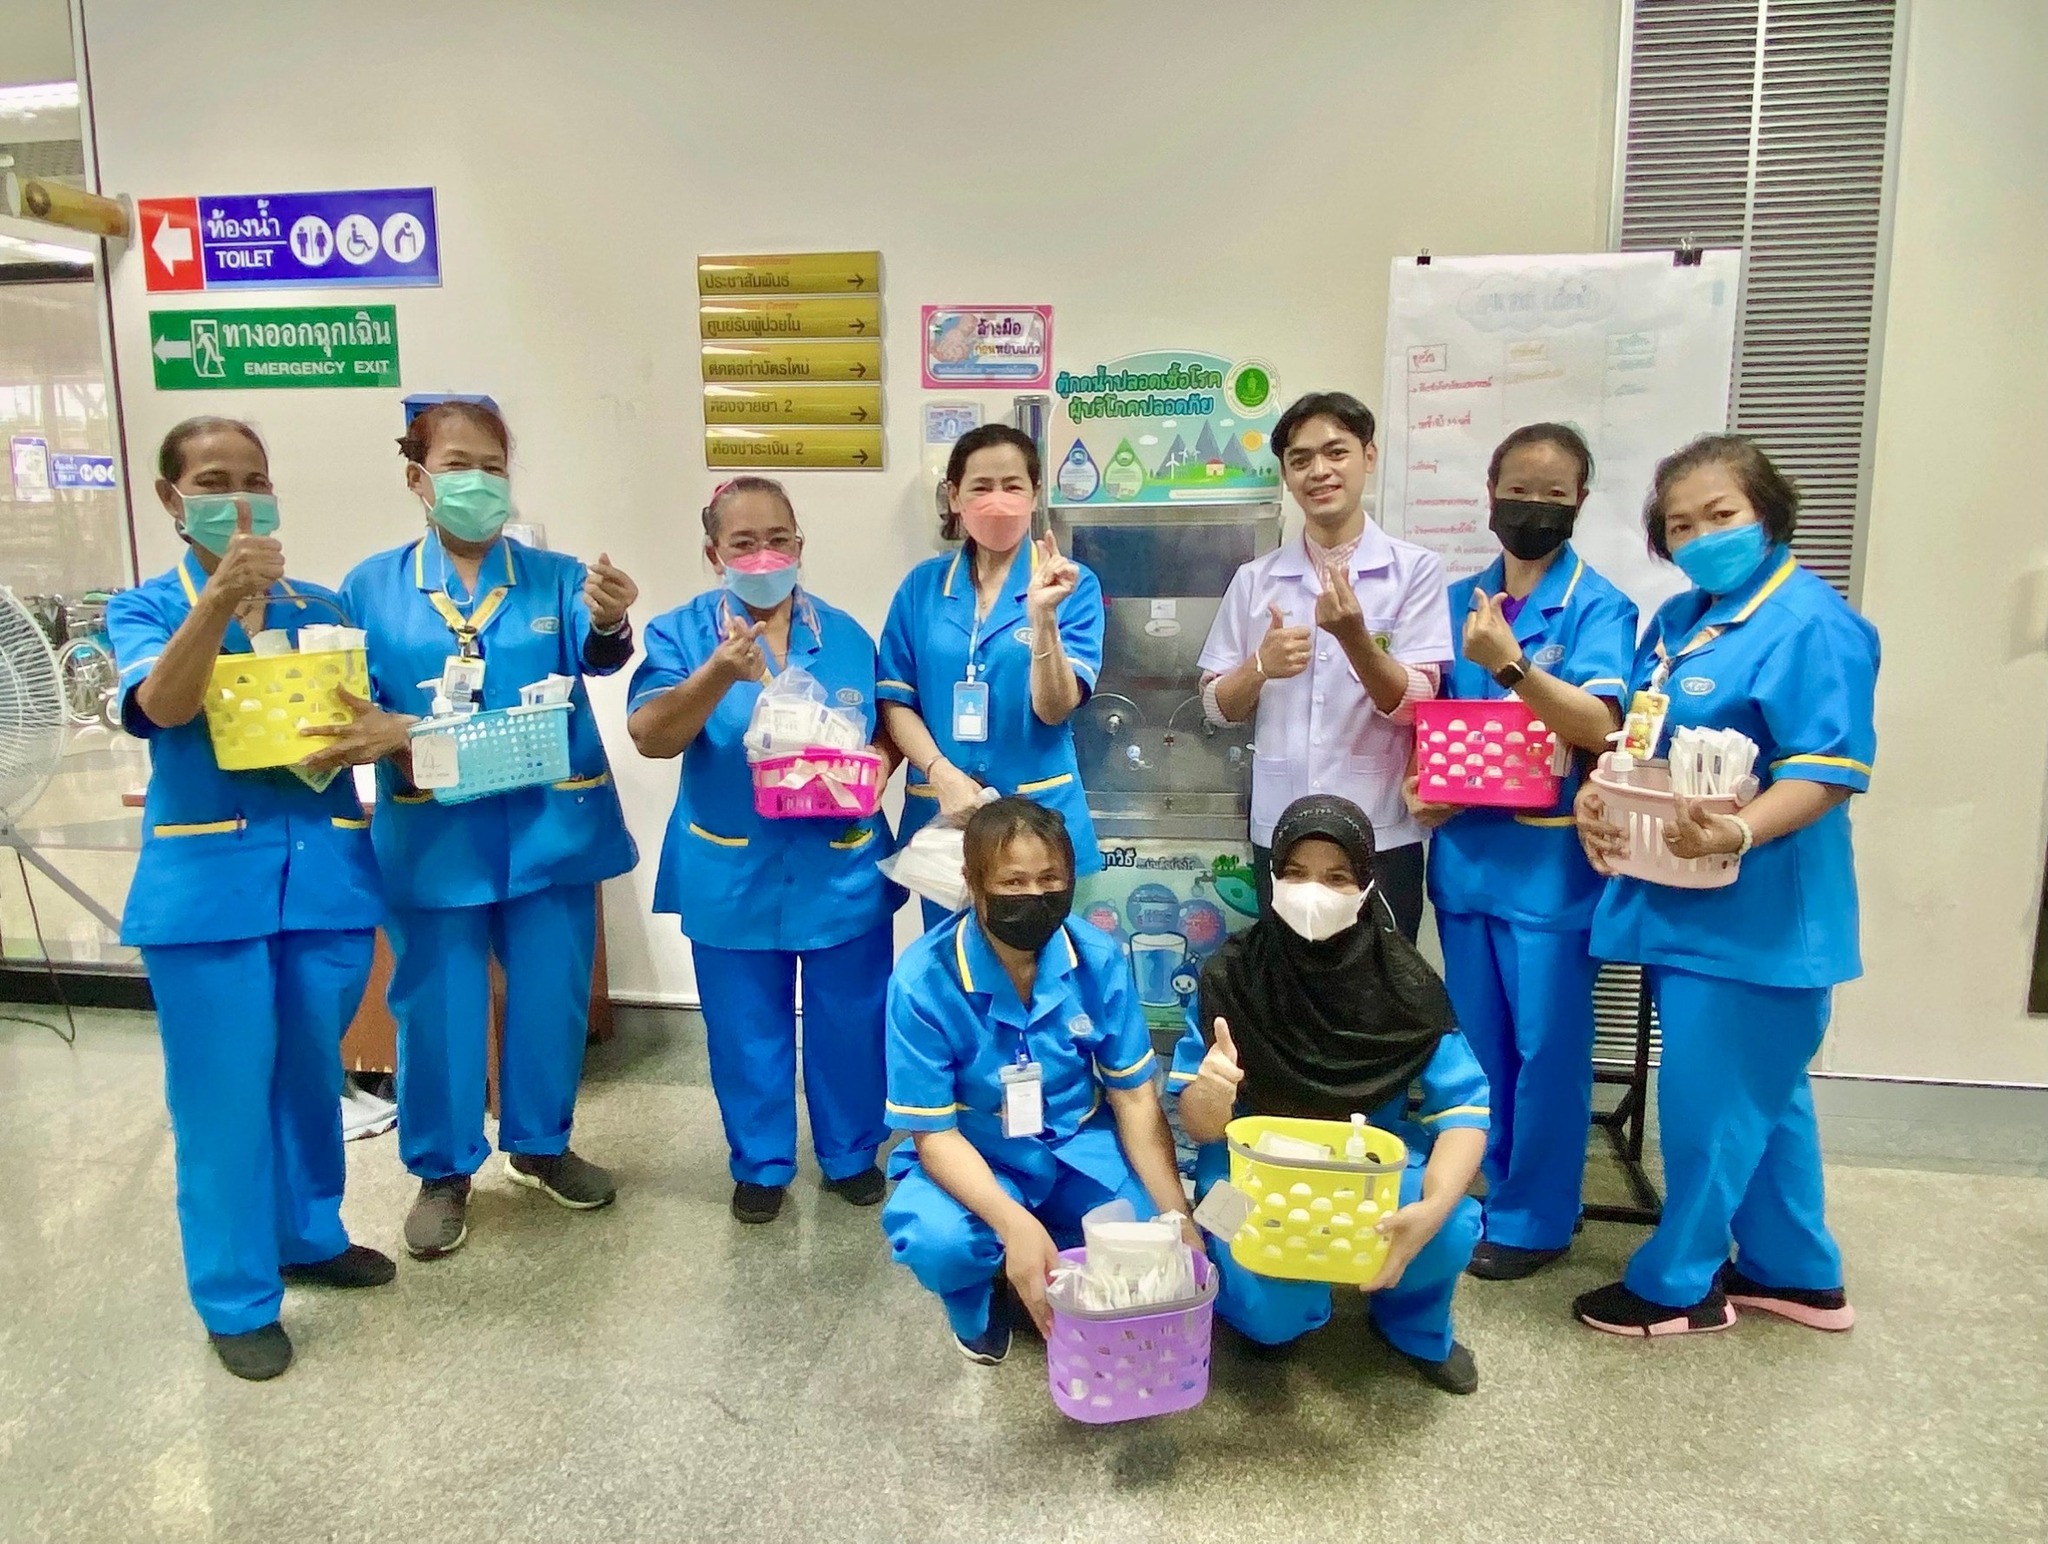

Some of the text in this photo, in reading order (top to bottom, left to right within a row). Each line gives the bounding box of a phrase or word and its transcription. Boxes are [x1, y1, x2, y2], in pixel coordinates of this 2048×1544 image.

[207, 200, 280, 238] ห้องน้ำ
[215, 250, 274, 268] TOILET
[222, 311, 391, 357] ทางออกฉุกเฉิน
[977, 317, 1022, 337] ล้างมือ
[244, 360, 389, 375] EMERGENCY EXIT
[1056, 361, 1222, 397] ตู้กดน้ำปลอดเชื้อโรค
[784, 399, 793, 413] 2
[1069, 393, 1214, 423] ผู้บริโภคปลอดภัย
[795, 442, 804, 455] 2
